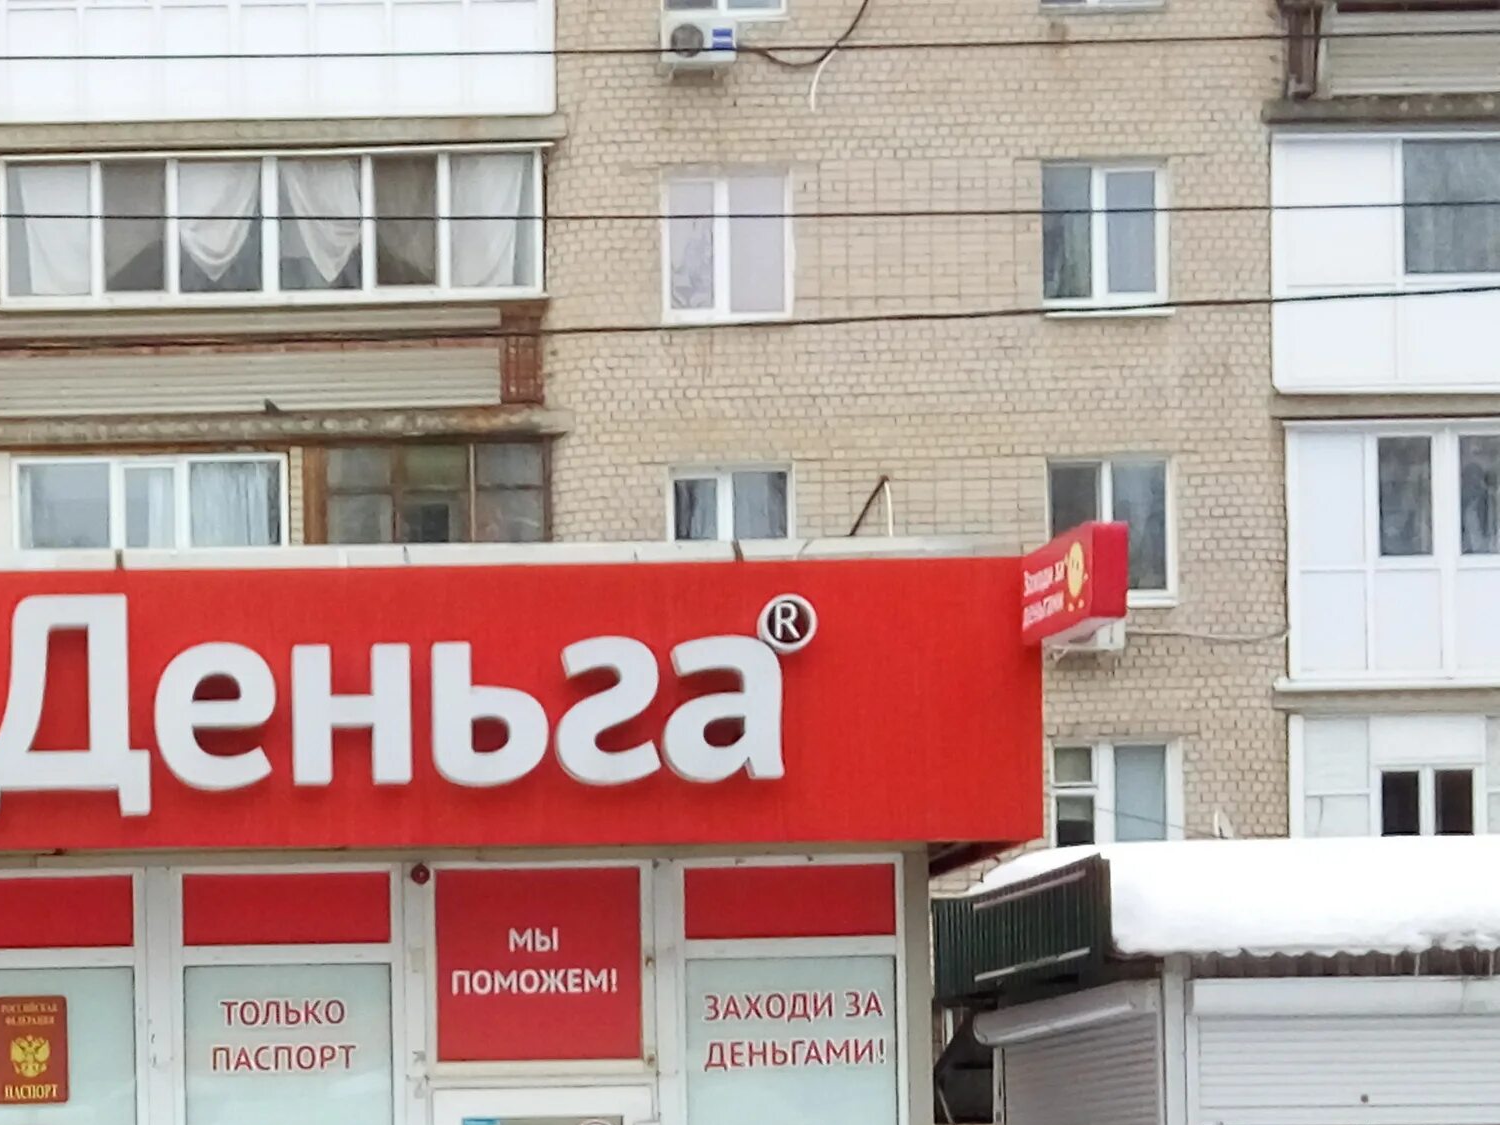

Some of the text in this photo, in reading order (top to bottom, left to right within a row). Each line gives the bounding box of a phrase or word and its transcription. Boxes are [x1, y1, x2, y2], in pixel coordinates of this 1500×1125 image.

[509, 926, 559, 952] МЫ
[452, 968, 618, 996] ПОМОЖЕМ!
[221, 999, 345, 1026] ТОЛЬКО
[704, 991, 883, 1023] ЗАХОДИ ЗА
[212, 1045, 357, 1072] ПАСПОРТ
[704, 1038, 885, 1072] ДЕНЬГАМИ!
[4, 1083, 58, 1099] ПАСПОРТ
